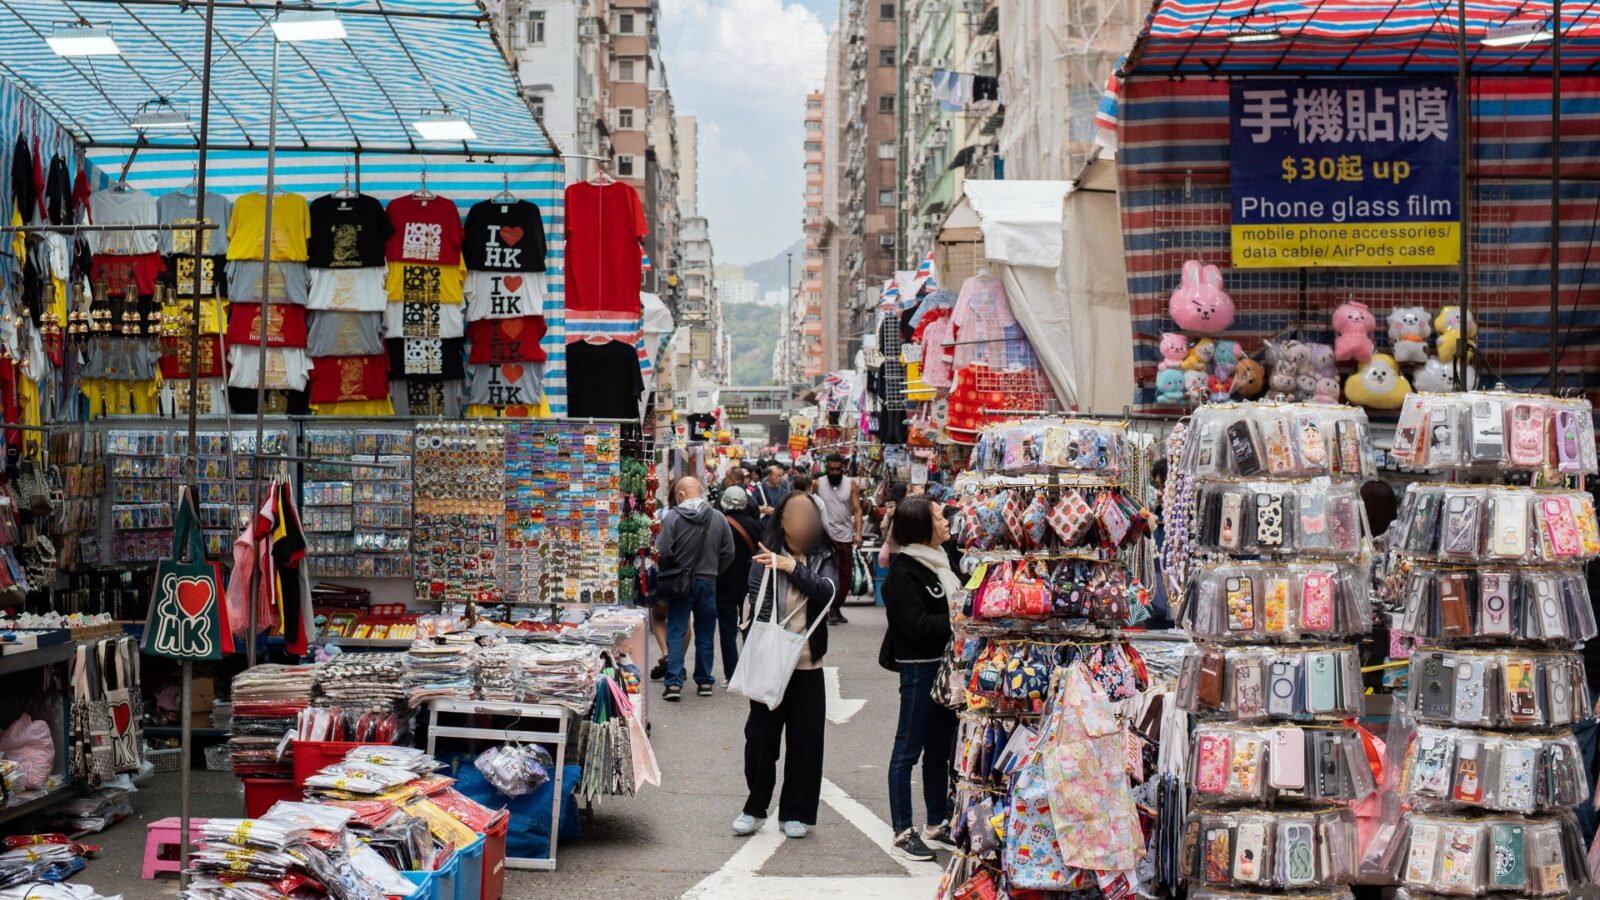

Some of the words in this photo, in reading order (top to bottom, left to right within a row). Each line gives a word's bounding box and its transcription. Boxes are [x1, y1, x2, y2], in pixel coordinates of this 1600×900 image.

[1240, 87, 1449, 144] 手機貼膜
[1281, 154, 1364, 183] $30起
[1373, 160, 1410, 183] up
[1241, 196, 1324, 218] Phone
[1331, 196, 1400, 222] glass
[1407, 195, 1451, 216] film
[486, 225, 501, 247] I
[1242, 226, 1295, 241] mobile
[1299, 226, 1348, 242] phone
[1352, 225, 1451, 238] accessories/
[484, 248, 522, 268] HK
[1242, 245, 1278, 258] data
[1281, 244, 1330, 258] cable/
[1332, 243, 1395, 257] AirPods
[1399, 245, 1436, 256] case
[490, 277, 502, 295] I
[490, 296, 521, 314] HK
[490, 342, 524, 361] HK
[488, 364, 501, 385] I
[488, 386, 523, 405] HK
[157, 615, 211, 656] HK
